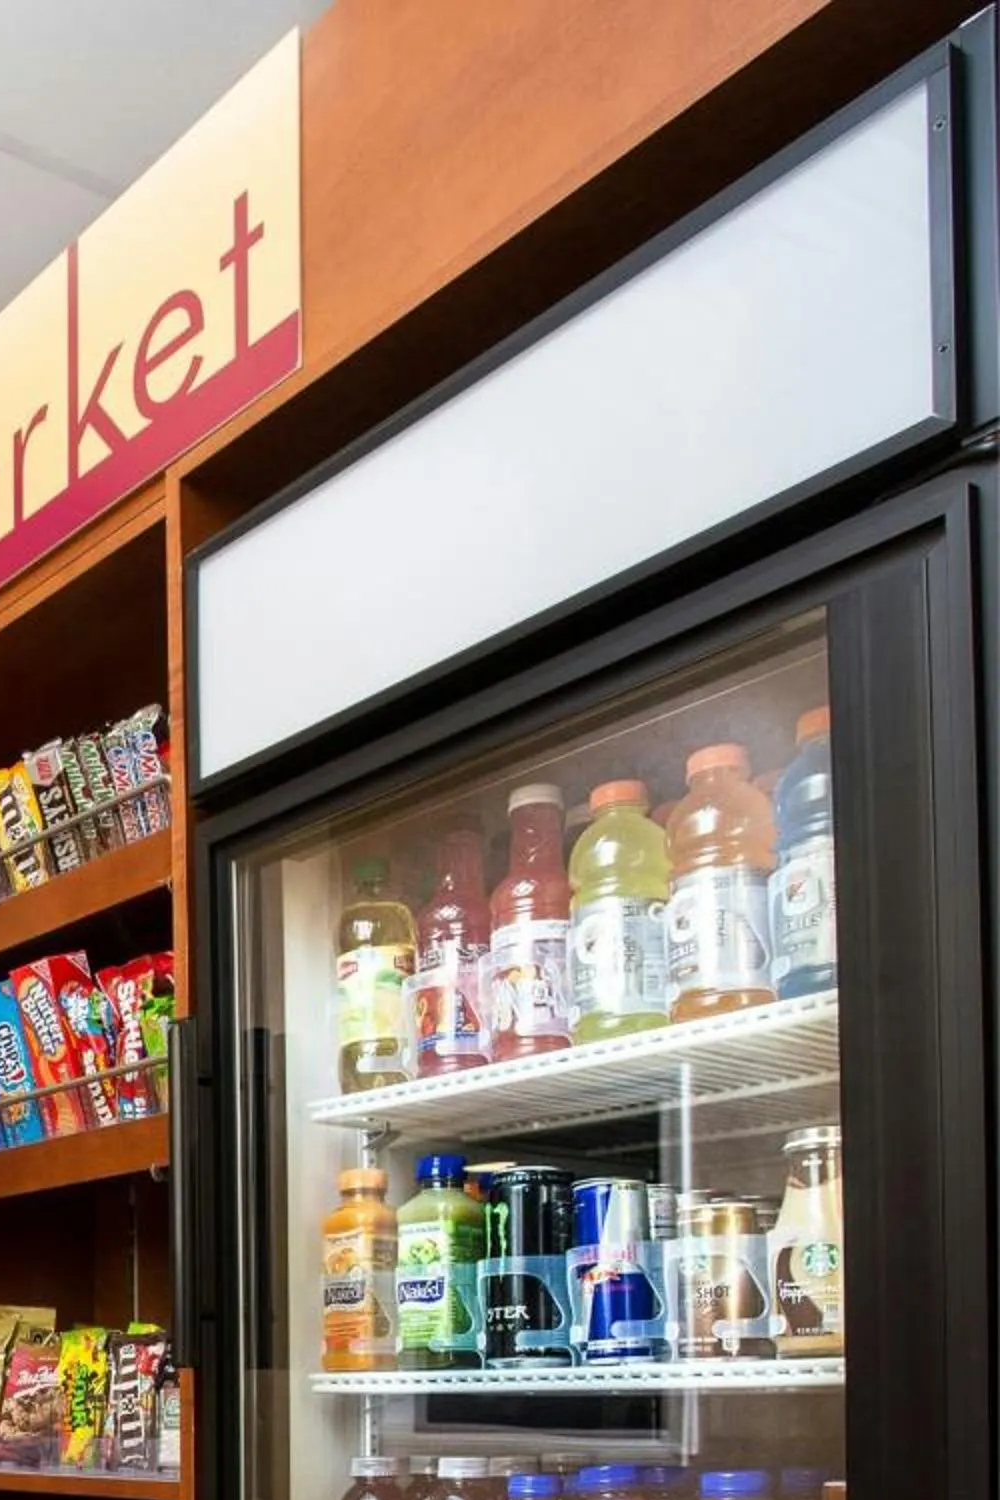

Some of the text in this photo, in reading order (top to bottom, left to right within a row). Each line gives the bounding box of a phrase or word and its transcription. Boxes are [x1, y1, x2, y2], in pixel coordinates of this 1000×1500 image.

[20, 1000, 56, 1056] Butter
[30, 980, 64, 1044] Nutter
[487, 1305, 529, 1322] STER
